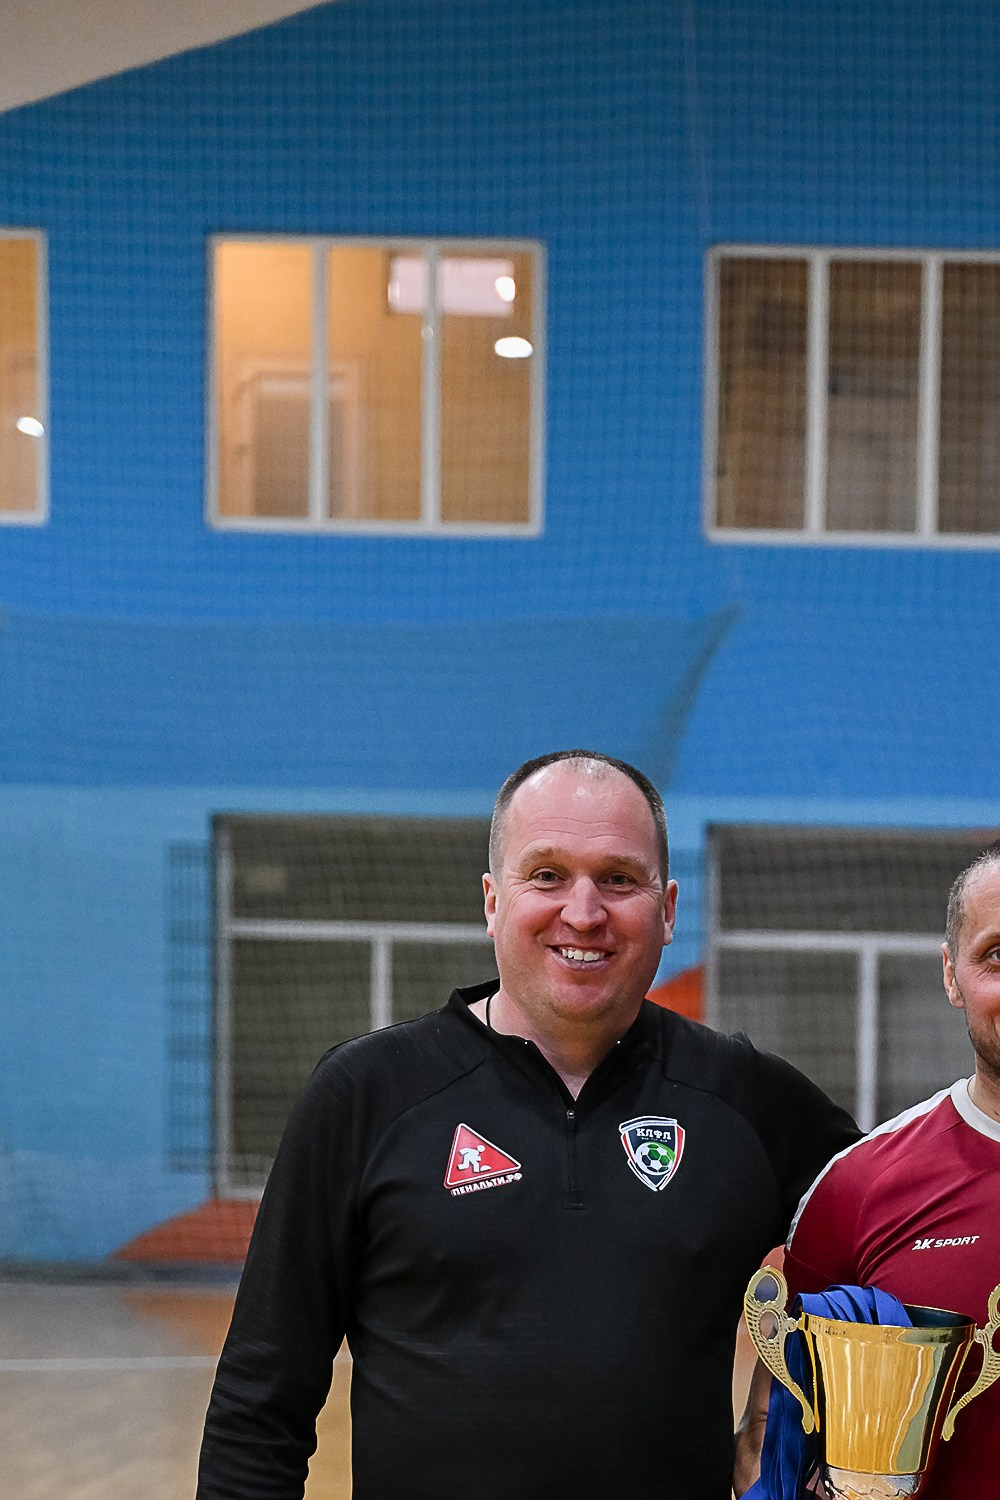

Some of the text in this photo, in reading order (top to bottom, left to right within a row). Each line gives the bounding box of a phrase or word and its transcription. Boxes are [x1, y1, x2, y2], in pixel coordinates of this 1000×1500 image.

[635, 1128, 672, 1140] КЛФЛ
[450, 1172, 523, 1197] ПЕНАЛЬТИ.РФ
[911, 1235, 980, 1251] 2K SPORT
